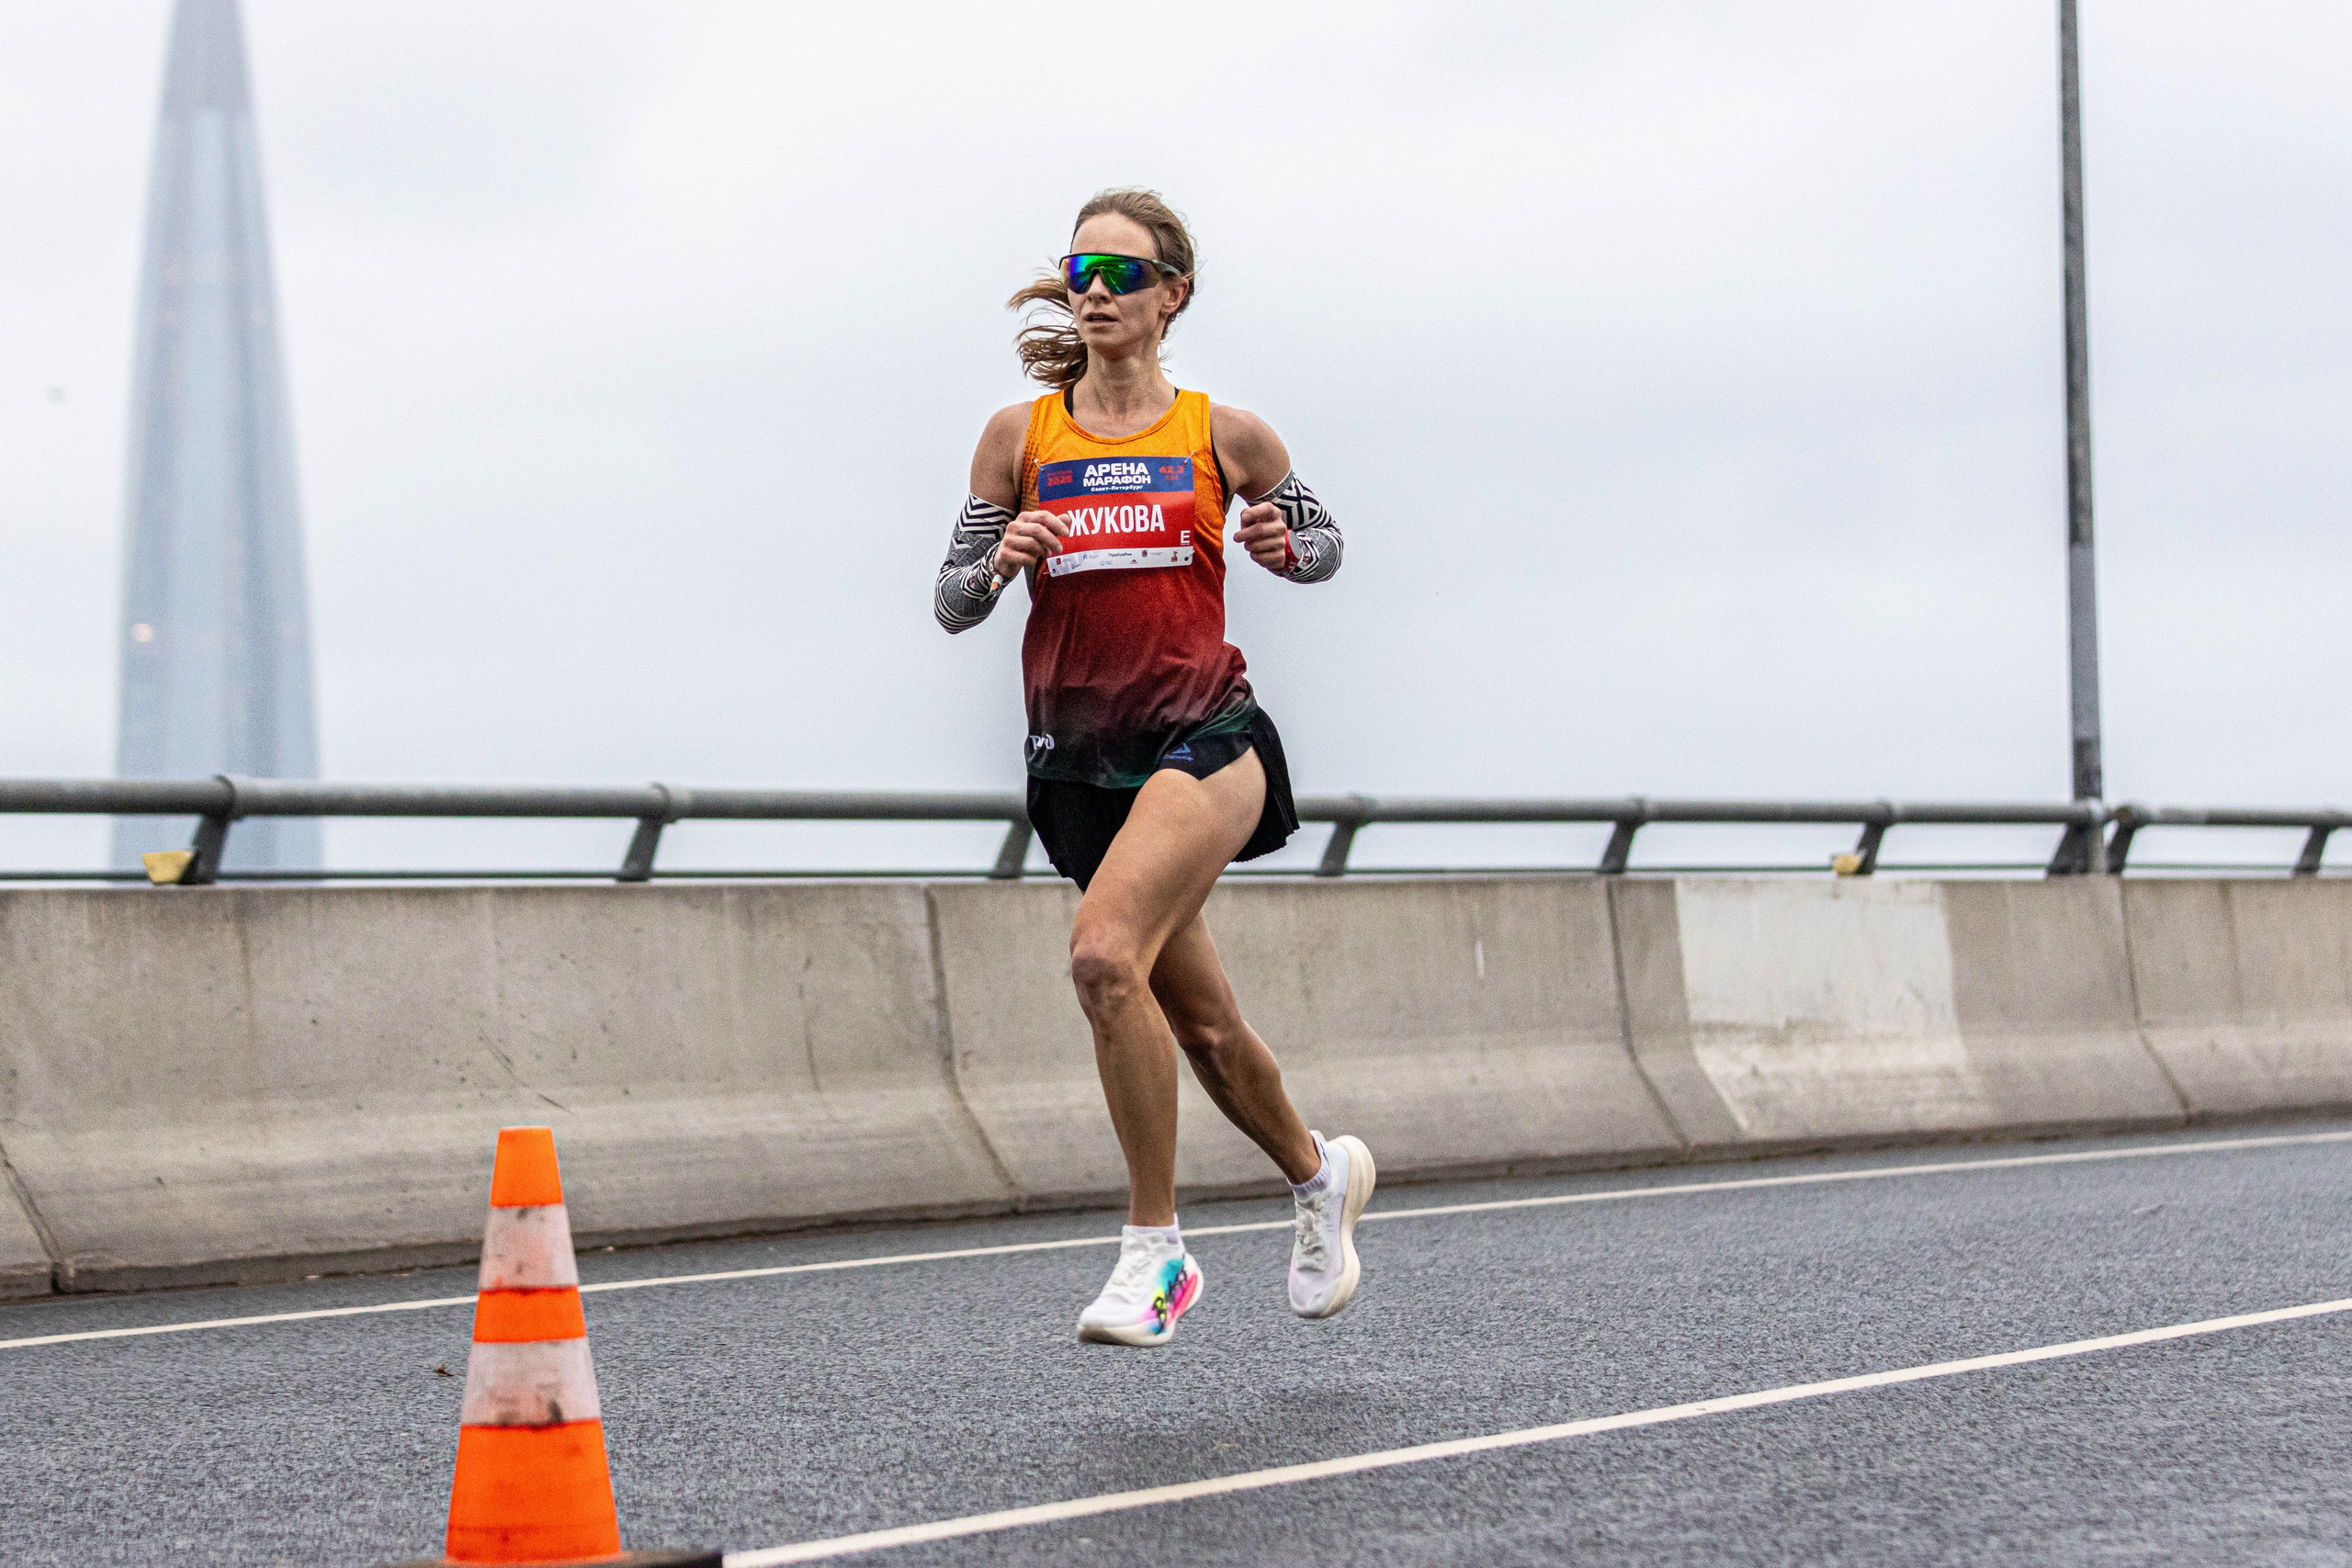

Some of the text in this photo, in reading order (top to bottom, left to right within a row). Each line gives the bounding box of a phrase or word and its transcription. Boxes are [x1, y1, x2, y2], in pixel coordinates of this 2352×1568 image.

[1084, 462, 1148, 477] АРЕНА
[1083, 475, 1151, 487] МАРАФОН
[1067, 504, 1165, 537] ЖУКОВА
